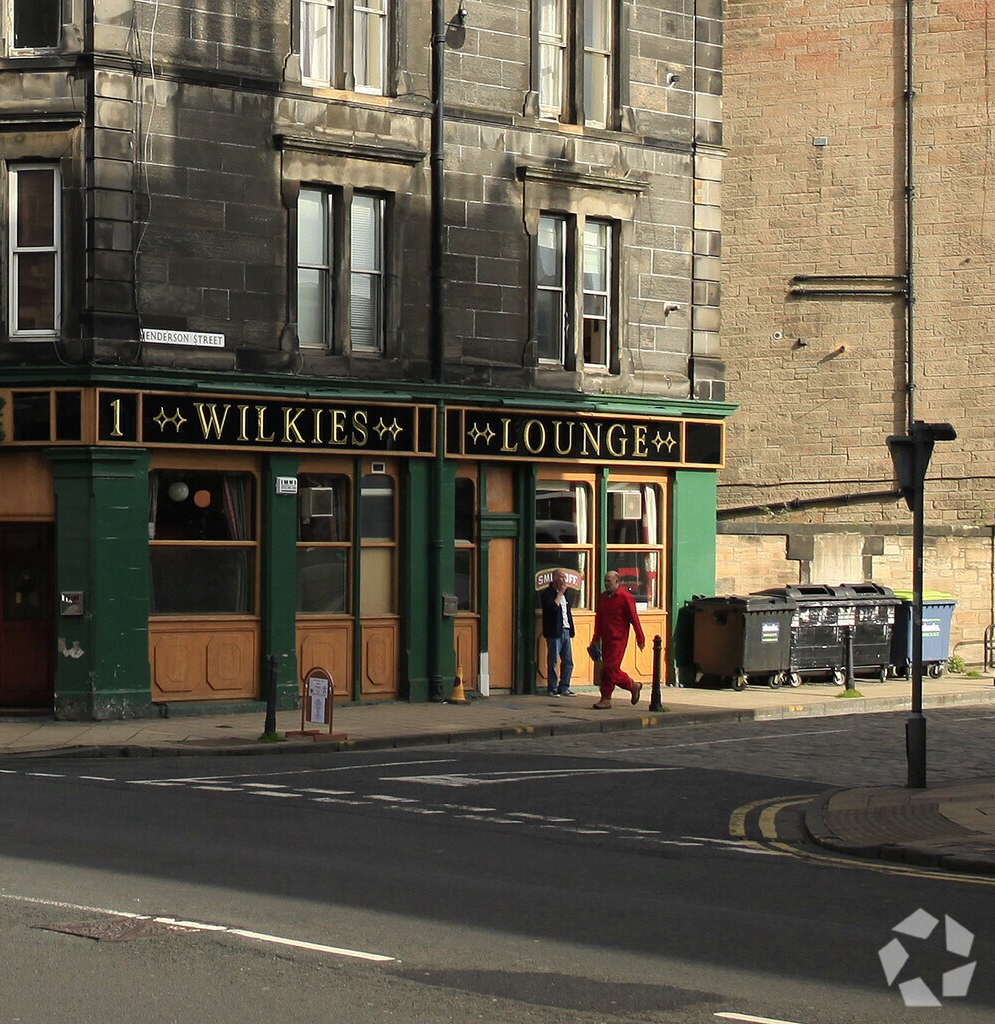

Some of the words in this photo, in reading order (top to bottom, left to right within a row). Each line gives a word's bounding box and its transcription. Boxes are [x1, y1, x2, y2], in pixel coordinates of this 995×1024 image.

[193, 334, 223, 345] STREET
[110, 398, 123, 436] 1
[193, 402, 368, 446] WILKIES
[500, 417, 649, 457] LOUNGE
